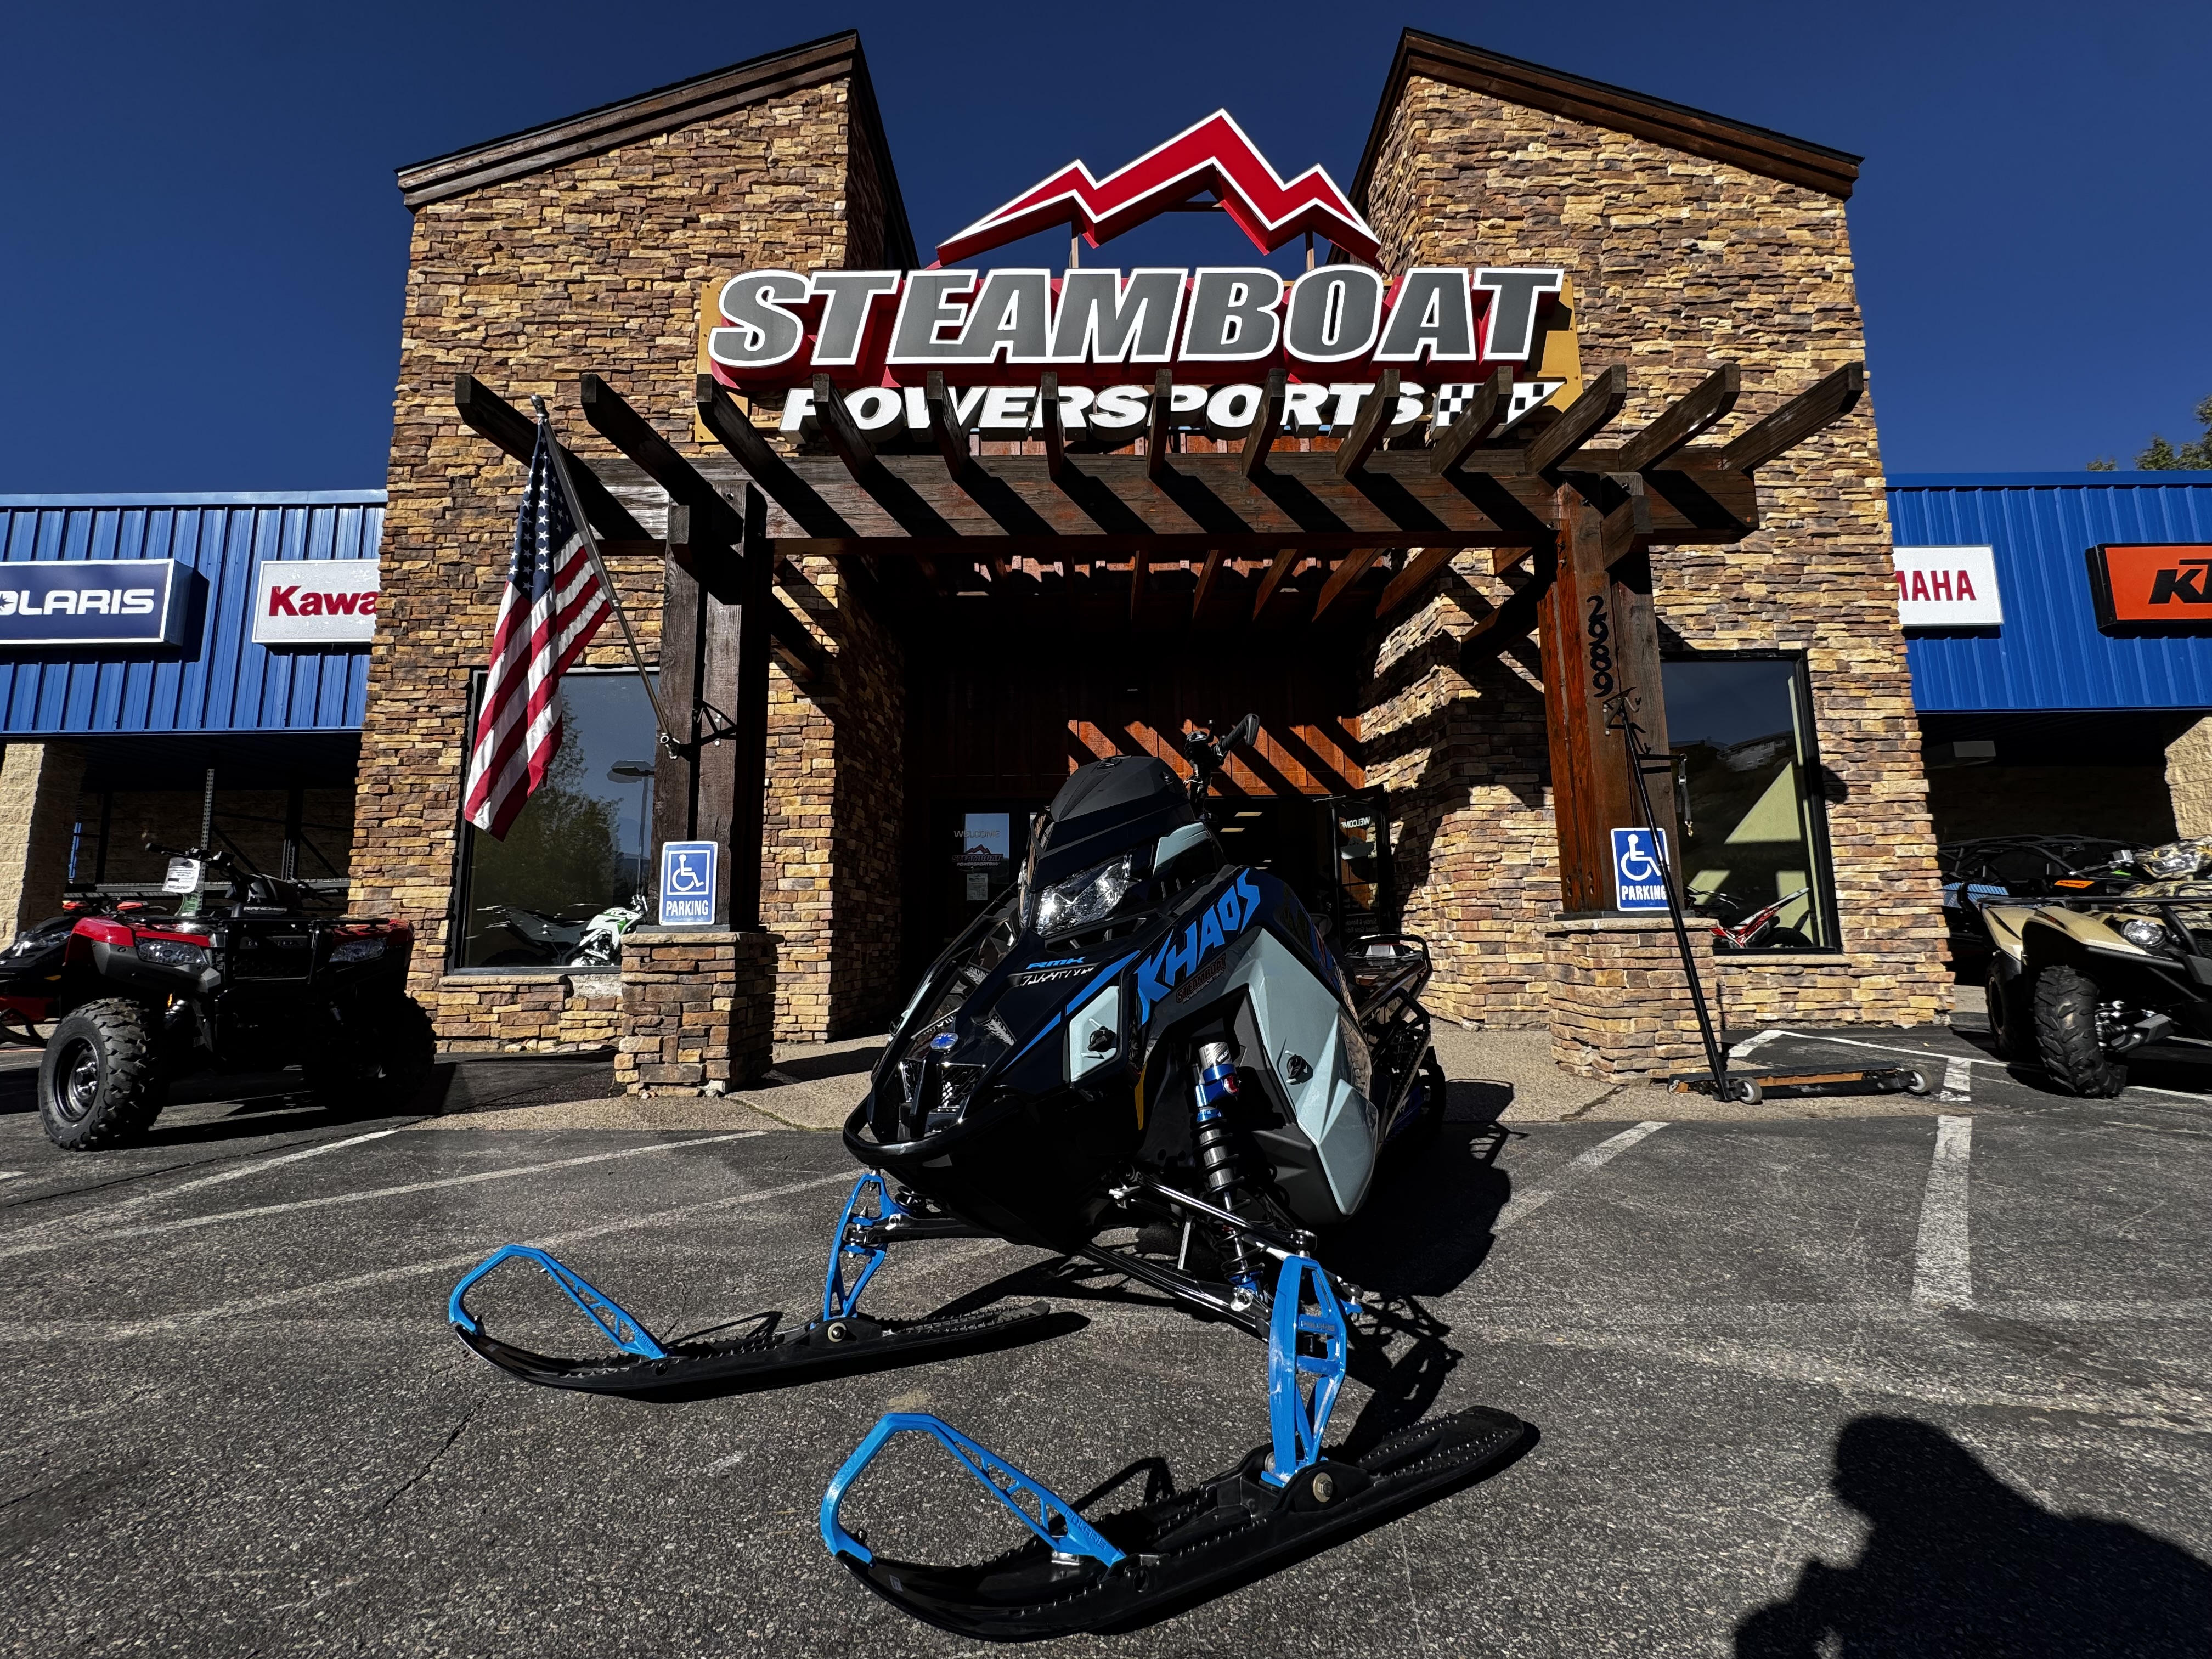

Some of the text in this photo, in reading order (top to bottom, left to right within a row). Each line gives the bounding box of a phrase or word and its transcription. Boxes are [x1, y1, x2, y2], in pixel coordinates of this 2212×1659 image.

[708, 264, 1565, 367] STEAMBOAT
[780, 381, 1426, 432] POWERSPORTS
[1586, 595, 1613, 698] 2989
[953, 830, 1000, 838] WELCOME
[665, 900, 709, 916] PARKING
[1621, 885, 1667, 900] PARKING
[1025, 956, 1086, 970] RMK
[1133, 868, 1262, 1026] KHAOS
[1177, 954, 1226, 1002] STEAMBOAT
[630, 1323, 656, 1352] POLARIS
[1064, 1508, 1108, 1550] POLARIS
